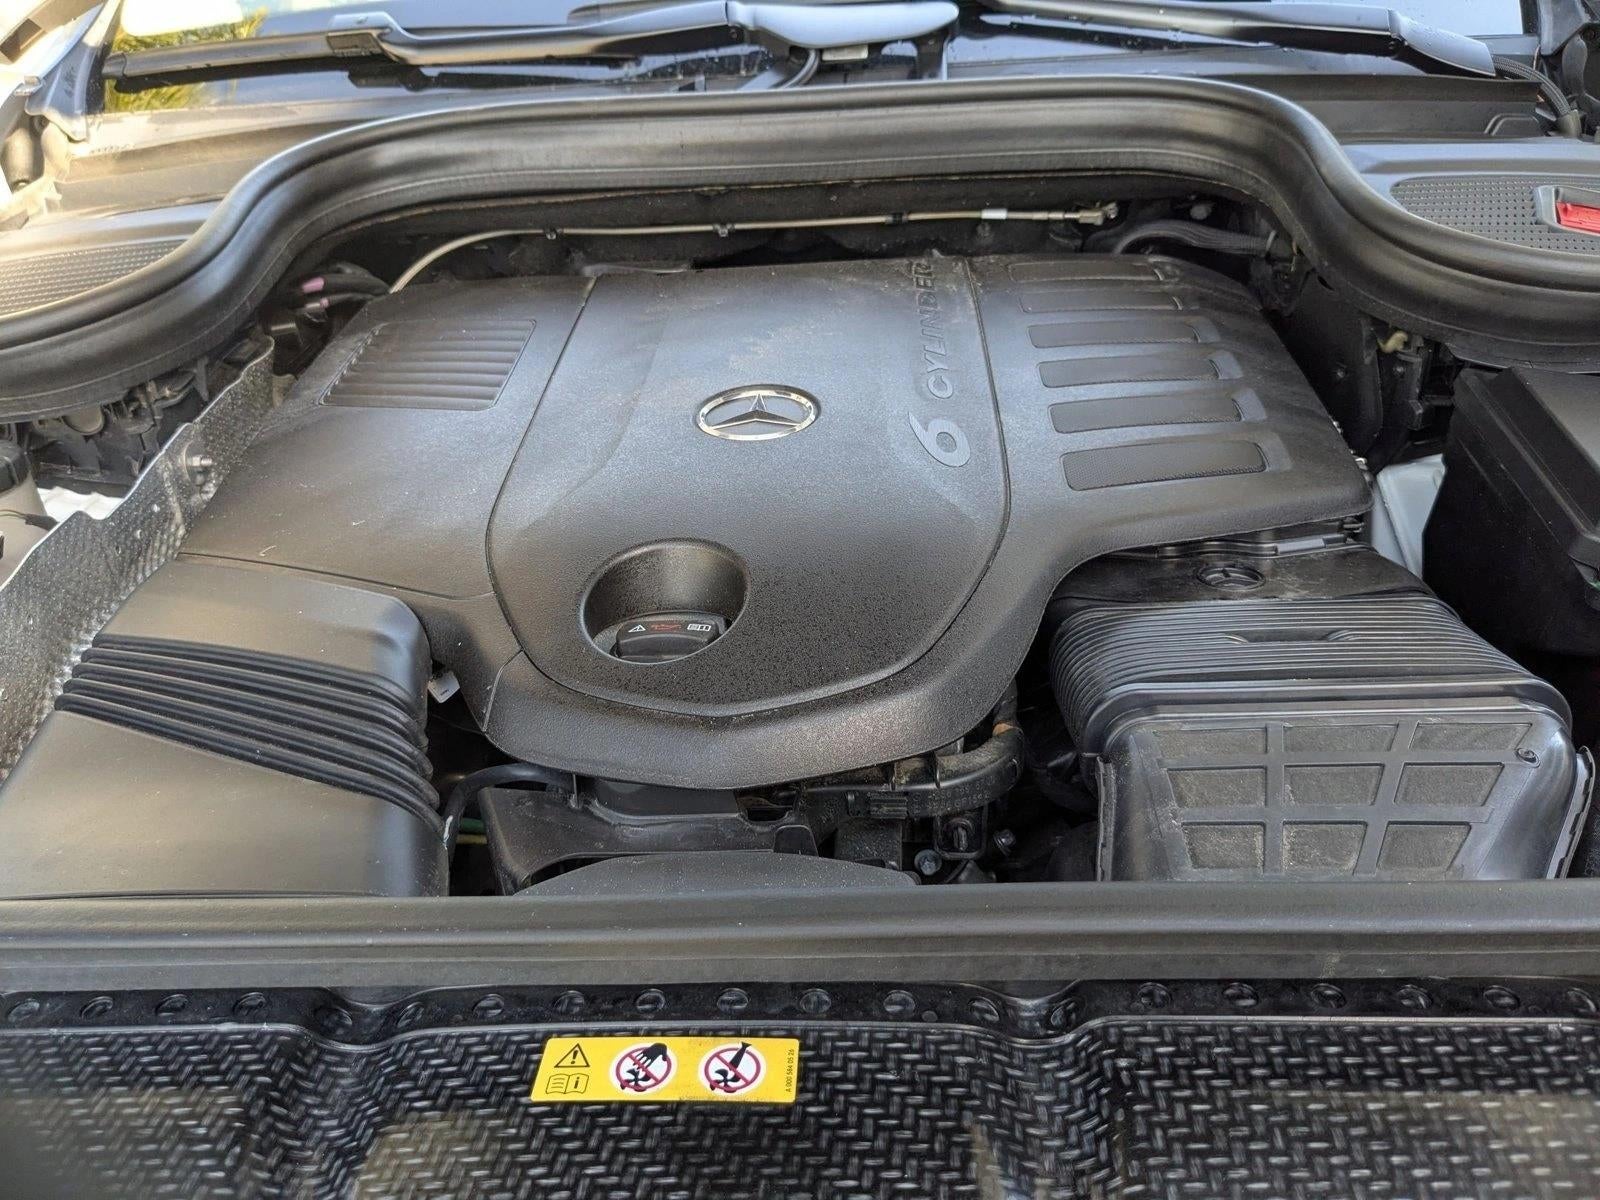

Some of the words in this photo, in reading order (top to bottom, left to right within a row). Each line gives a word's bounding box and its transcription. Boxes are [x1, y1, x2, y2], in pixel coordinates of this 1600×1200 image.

[912, 261, 954, 399] CYLINDER
[908, 411, 971, 468] 6
[787, 1056, 794, 1064] 05
[785, 1076, 793, 1087] 000
